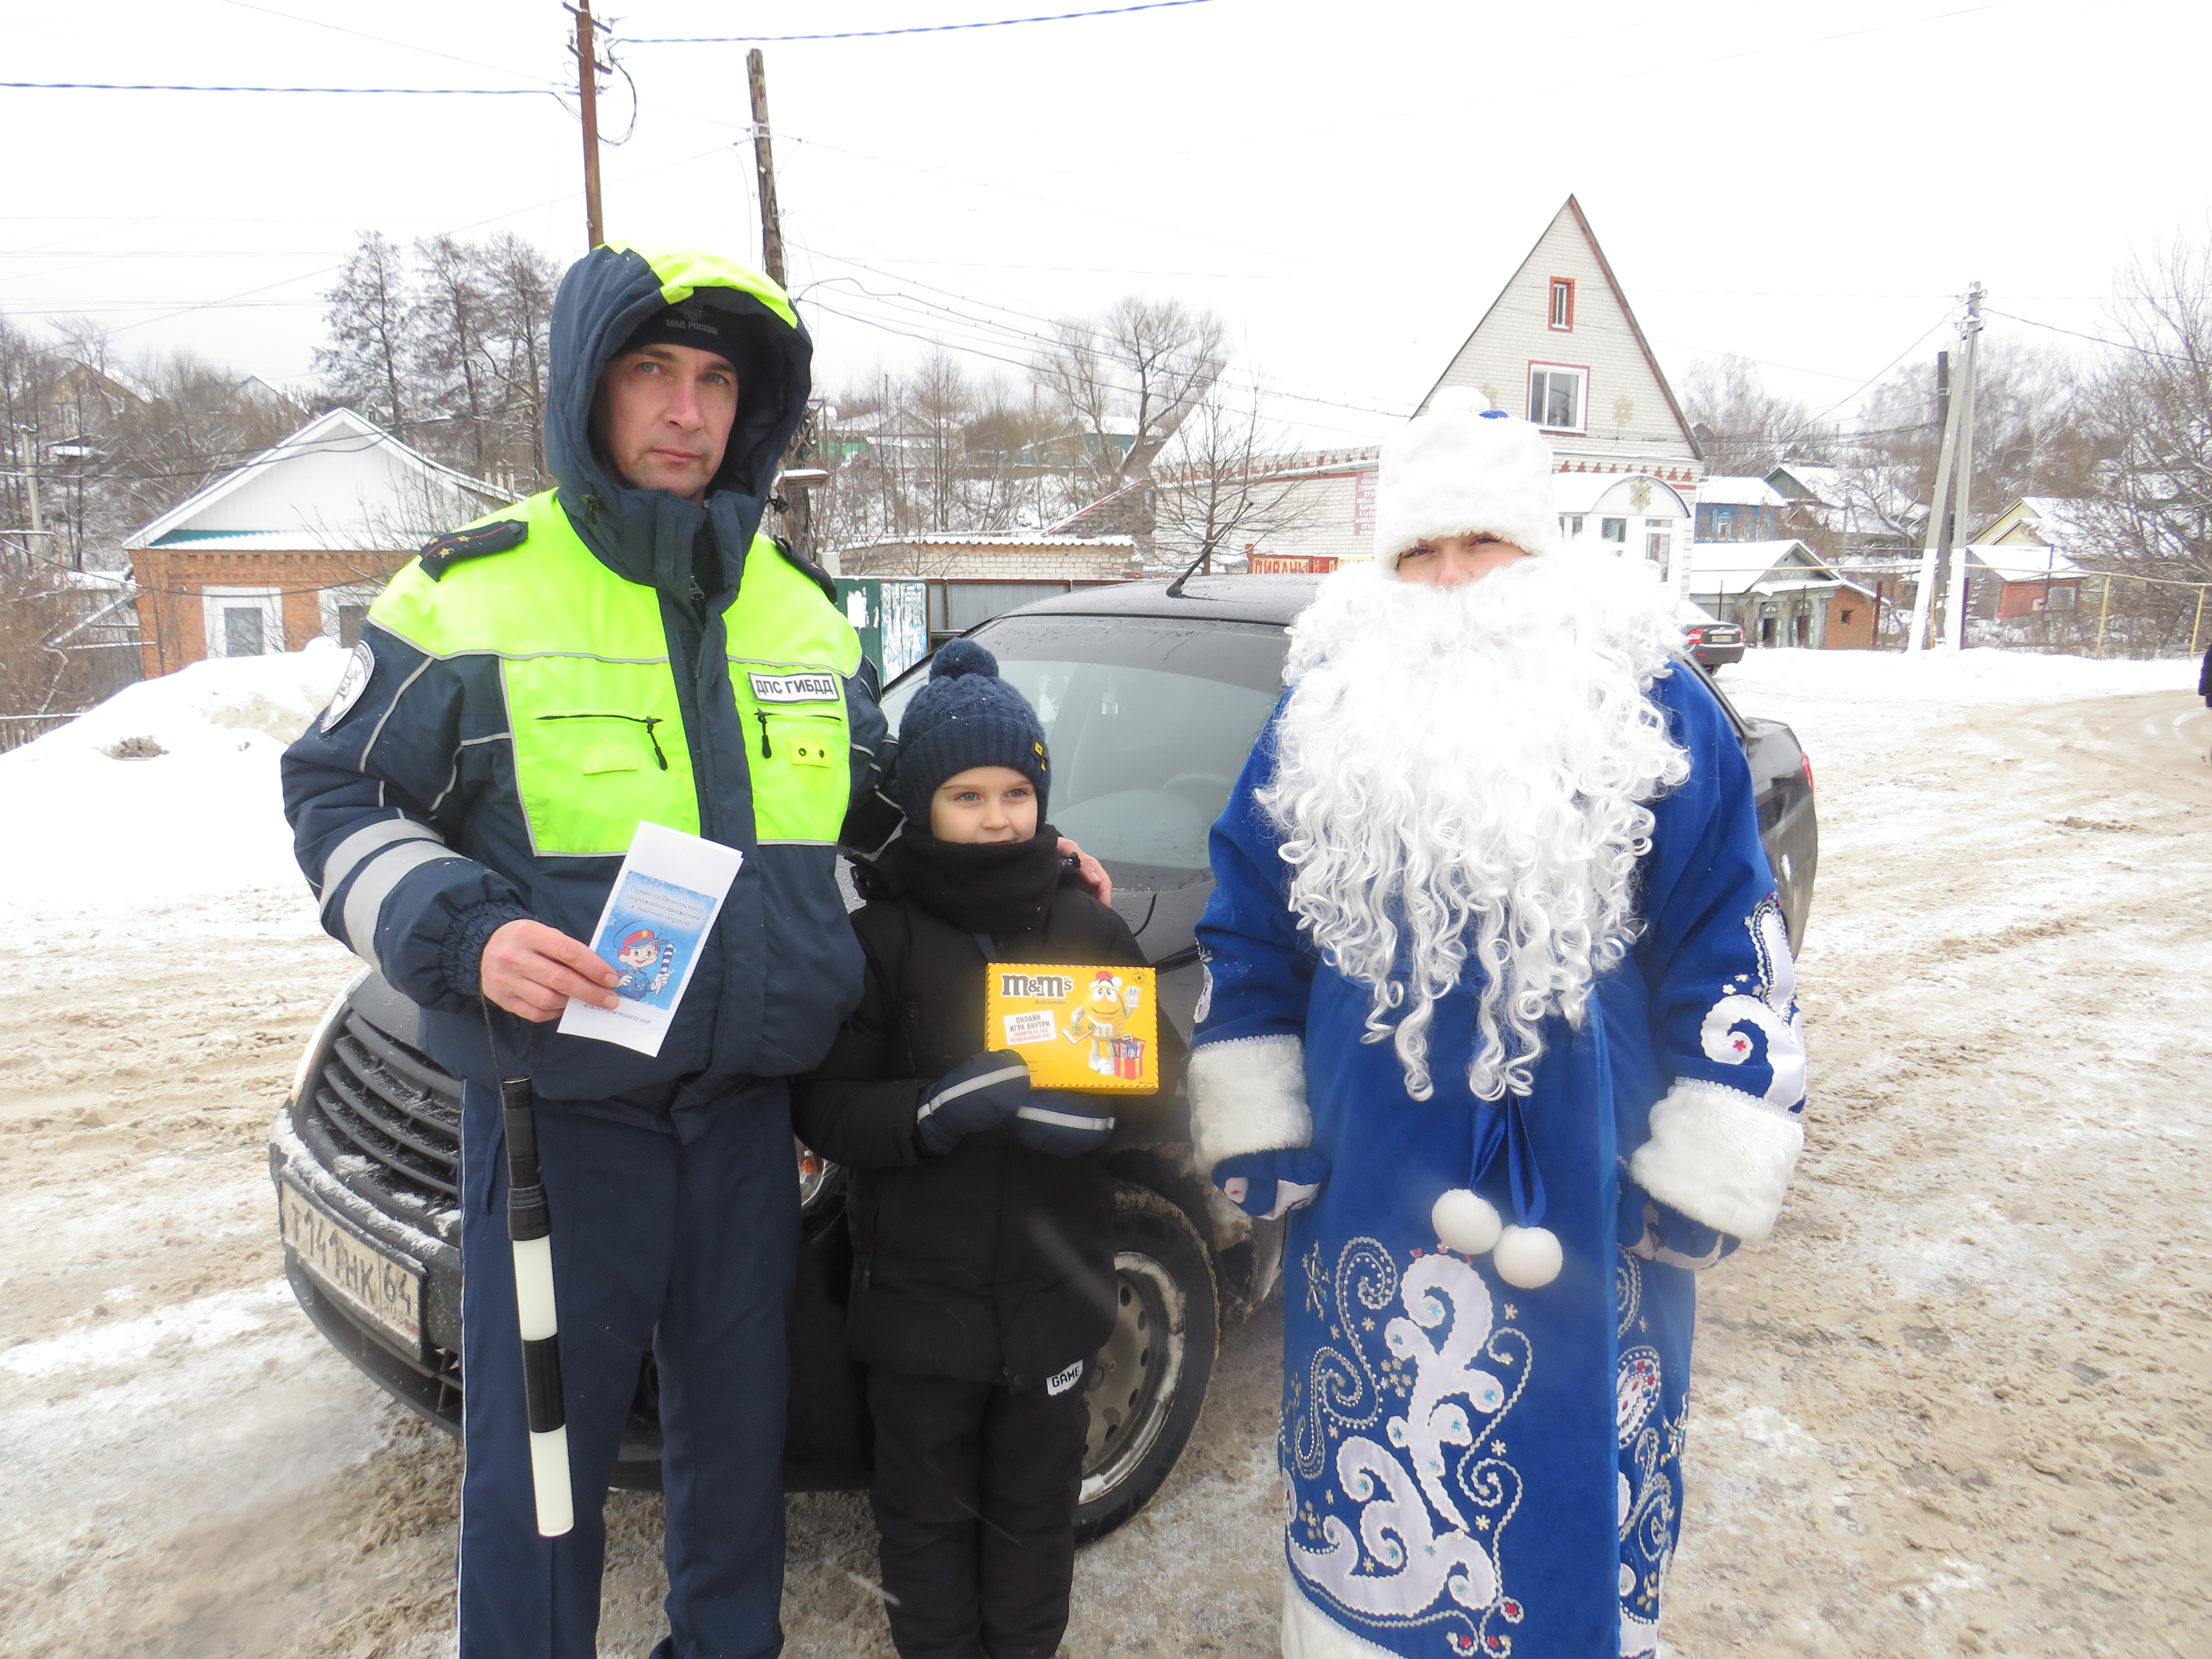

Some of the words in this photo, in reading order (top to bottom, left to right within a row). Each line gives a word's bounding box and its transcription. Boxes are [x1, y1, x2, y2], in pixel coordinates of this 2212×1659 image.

[755, 680, 783, 695] ДПС
[785, 680, 834, 695] ГИБДД
[626, 895, 665, 910] дорожного
[666, 907, 701, 921] движения
[630, 885, 661, 899] Правила
[662, 895, 704, 913] безопасного
[636, 905, 664, 917] зимний
[664, 915, 690, 926] период
[617, 1012, 651, 1025] РОДИТЕЛЕЙ
[1010, 1024, 1025, 1032] ИГРА
[1027, 1020, 1050, 1030] ВНУТРИ
[1016, 1013, 1041, 1023] ОНЛАЙН
[1052, 1366, 1080, 1387] GAME
